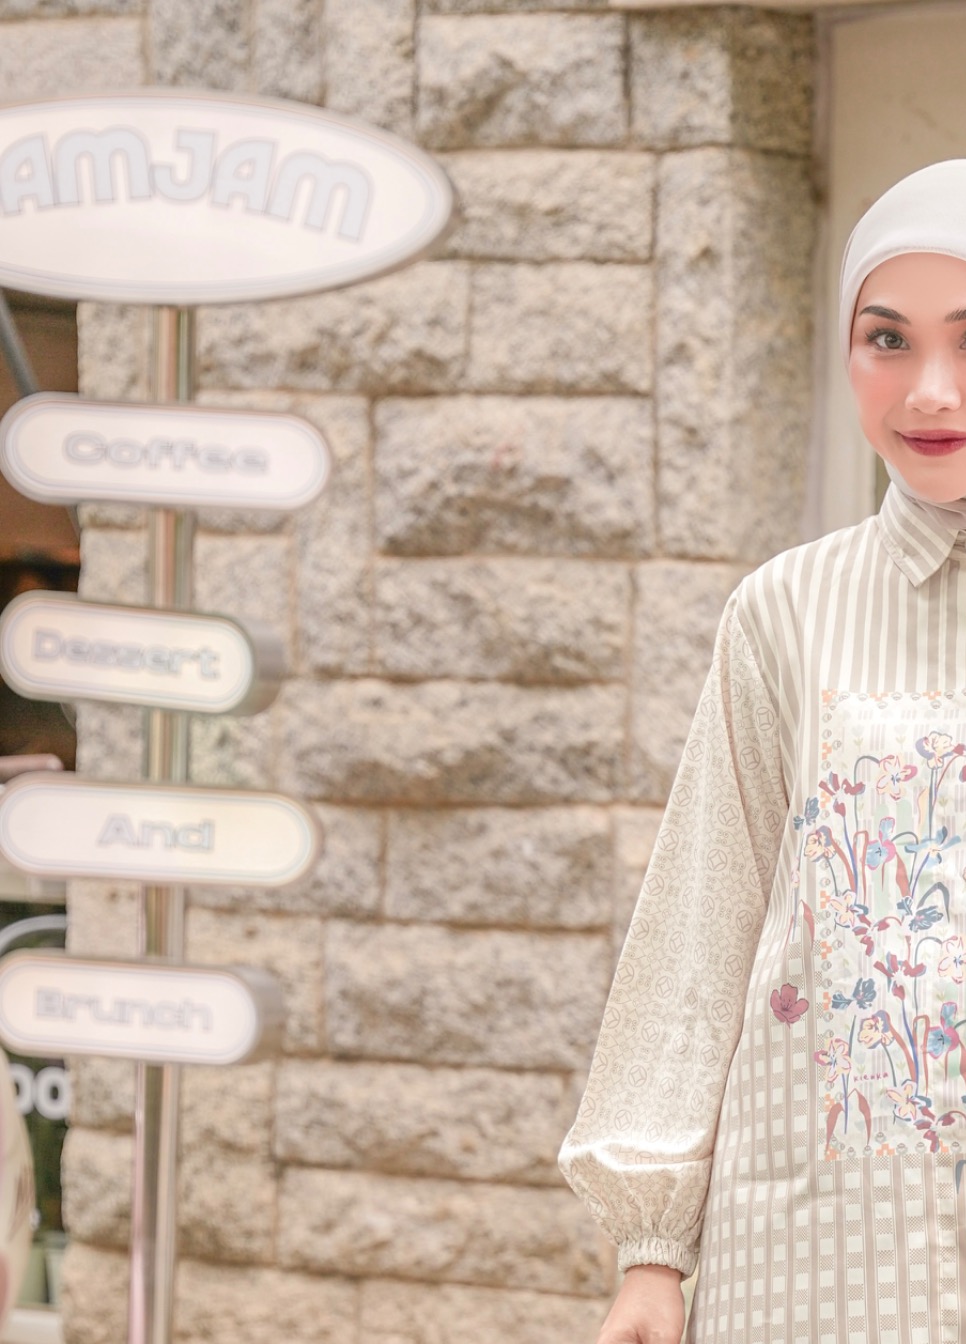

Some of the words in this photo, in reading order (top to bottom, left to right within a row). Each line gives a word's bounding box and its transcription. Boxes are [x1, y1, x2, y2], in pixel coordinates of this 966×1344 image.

[62, 429, 271, 475] Coffee
[32, 626, 222, 680] Dessert
[98, 813, 215, 852] And
[34, 986, 213, 1034] Brunch
